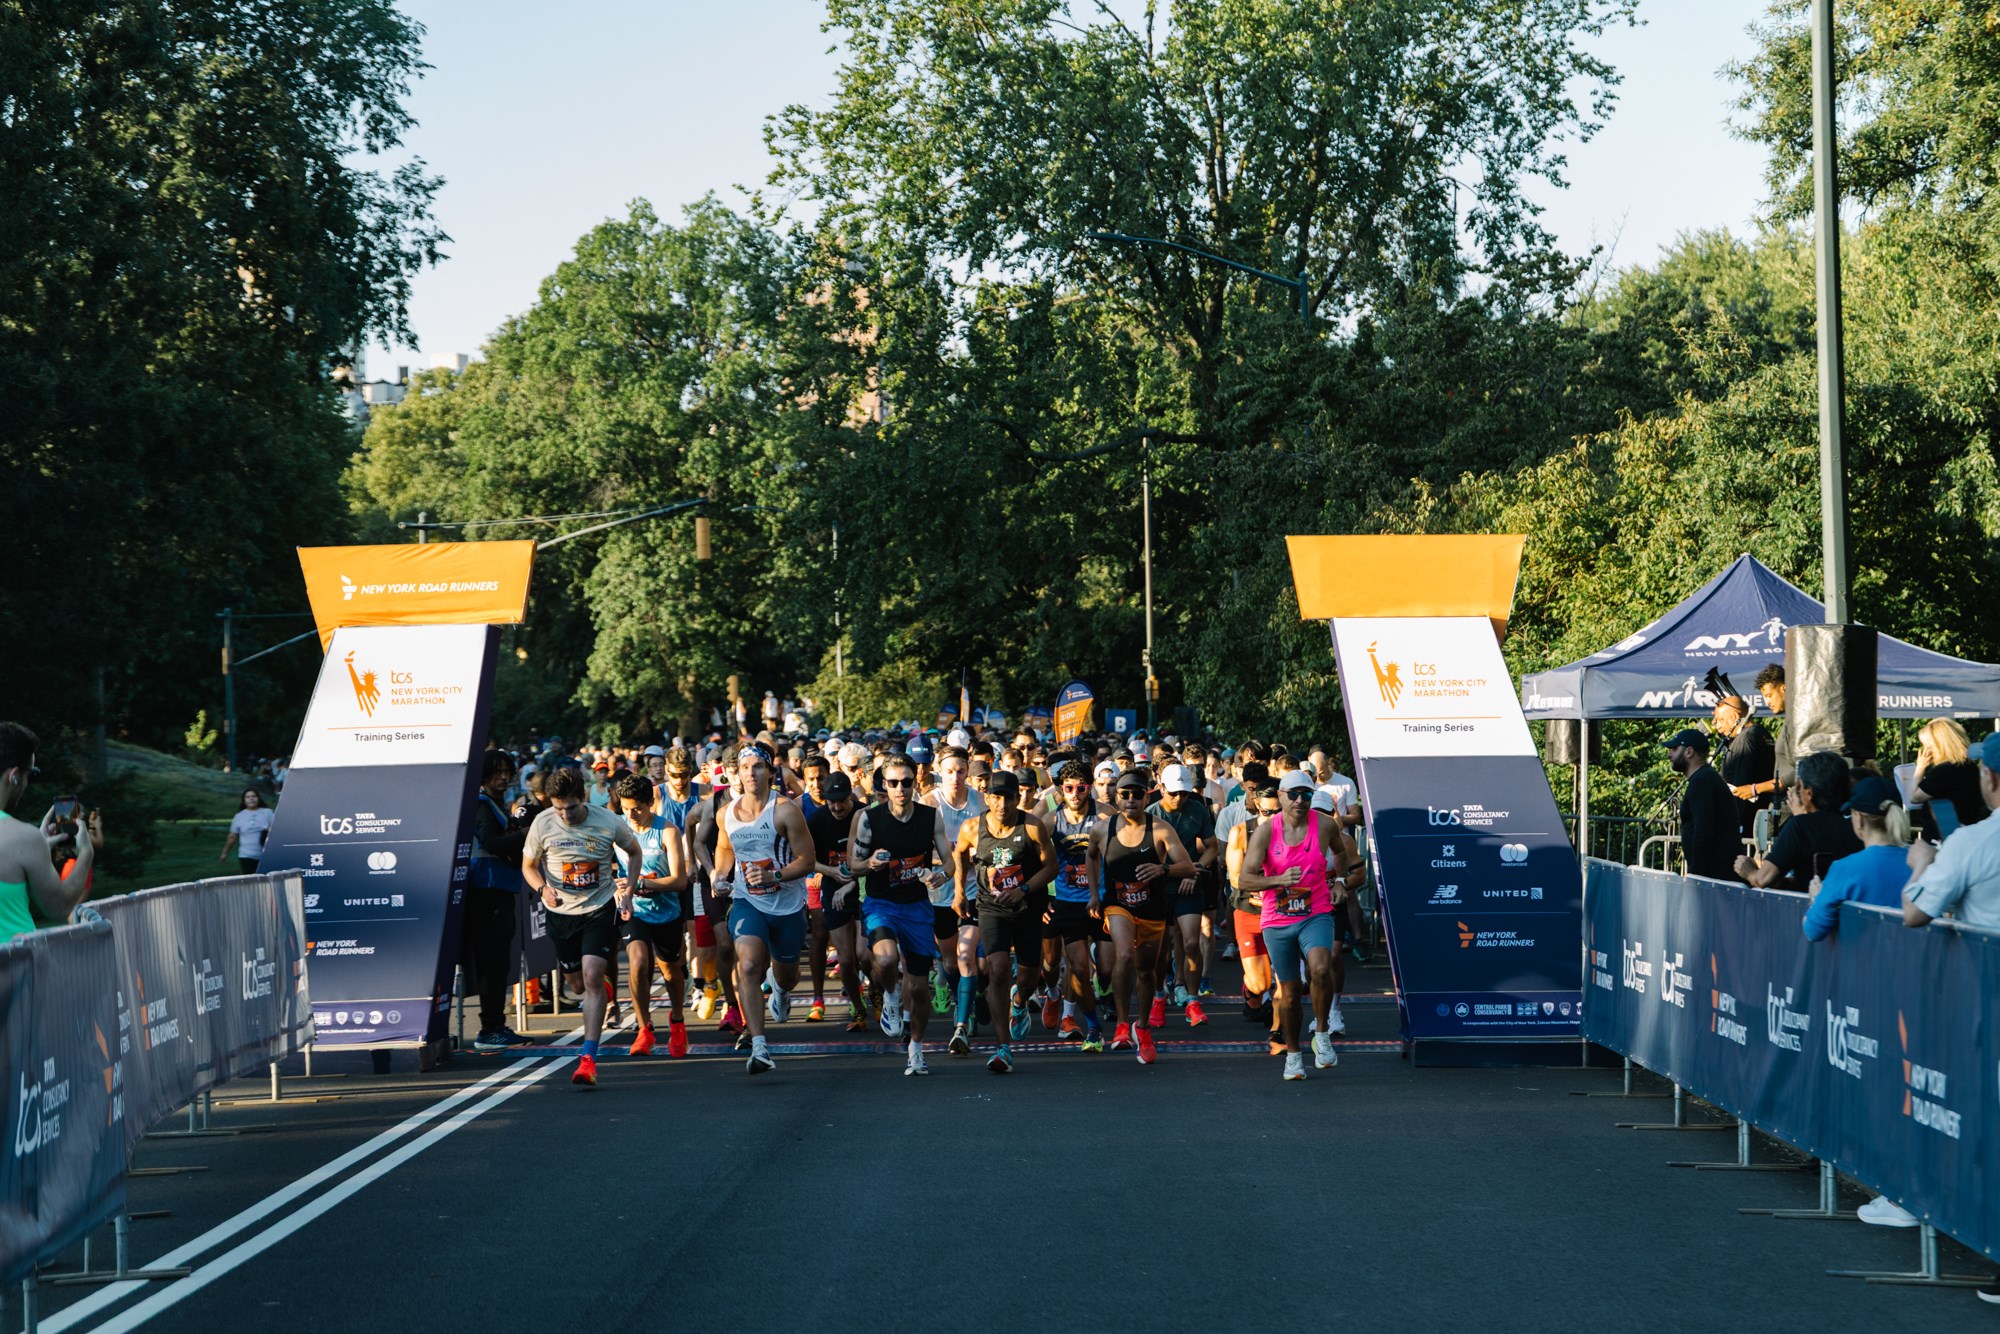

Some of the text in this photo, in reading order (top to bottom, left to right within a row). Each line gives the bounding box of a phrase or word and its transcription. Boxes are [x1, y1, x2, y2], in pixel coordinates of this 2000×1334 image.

[361, 581, 499, 595] NEW YORK ROAD RUNNERS
[1414, 661, 1436, 675] tcs
[391, 670, 413, 684] tcs
[1439, 679, 1464, 687] YORK
[1466, 679, 1487, 687] CITY
[391, 686, 463, 696] NEW YORK CITY
[1414, 689, 1469, 697] MARATHON
[391, 697, 446, 706] MARATHON
[1879, 695, 1953, 708] RUNNERS
[1115, 716, 1127, 732] B
[1403, 723, 1474, 734] Training Series
[354, 731, 425, 743] Training Series
[1428, 805, 1460, 826] tcs
[1463, 811, 1509, 819] CONSULTANCY
[320, 814, 353, 835] tcs
[355, 819, 402, 827] CONSULTANCY
[1431, 860, 1466, 868] Citizens
[574, 873, 596, 885] 5531
[1002, 876, 1018, 889] 194
[344, 898, 389, 906] UNITED
[1126, 891, 1147, 903] 3315
[1288, 899, 1305, 910] 104
[1499, 939, 1535, 947] RUNNERS
[316, 946, 375, 956] ROAD RUNNERS
[1827, 999, 1847, 1071] tcs
